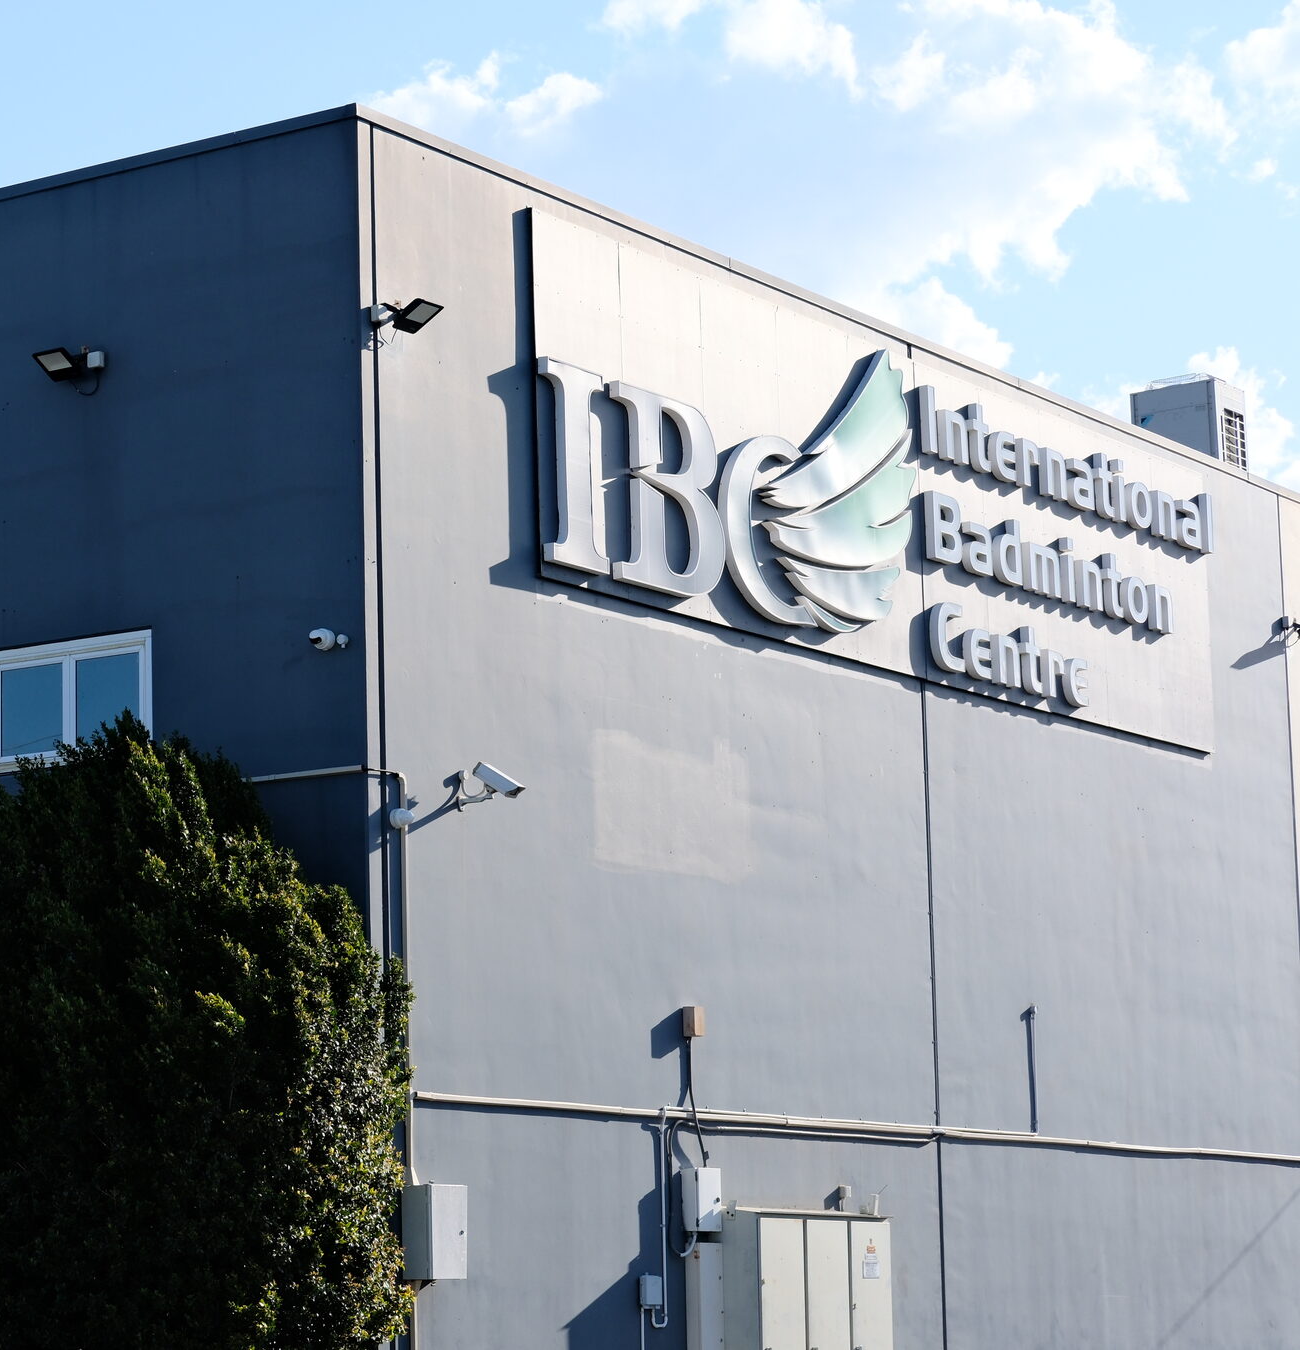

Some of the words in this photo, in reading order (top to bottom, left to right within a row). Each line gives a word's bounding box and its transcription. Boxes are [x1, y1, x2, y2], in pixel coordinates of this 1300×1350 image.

[538, 356, 818, 627] IBC
[919, 385, 1214, 554] International
[924, 490, 1174, 634] Badminton
[929, 602, 1089, 708] Centre
